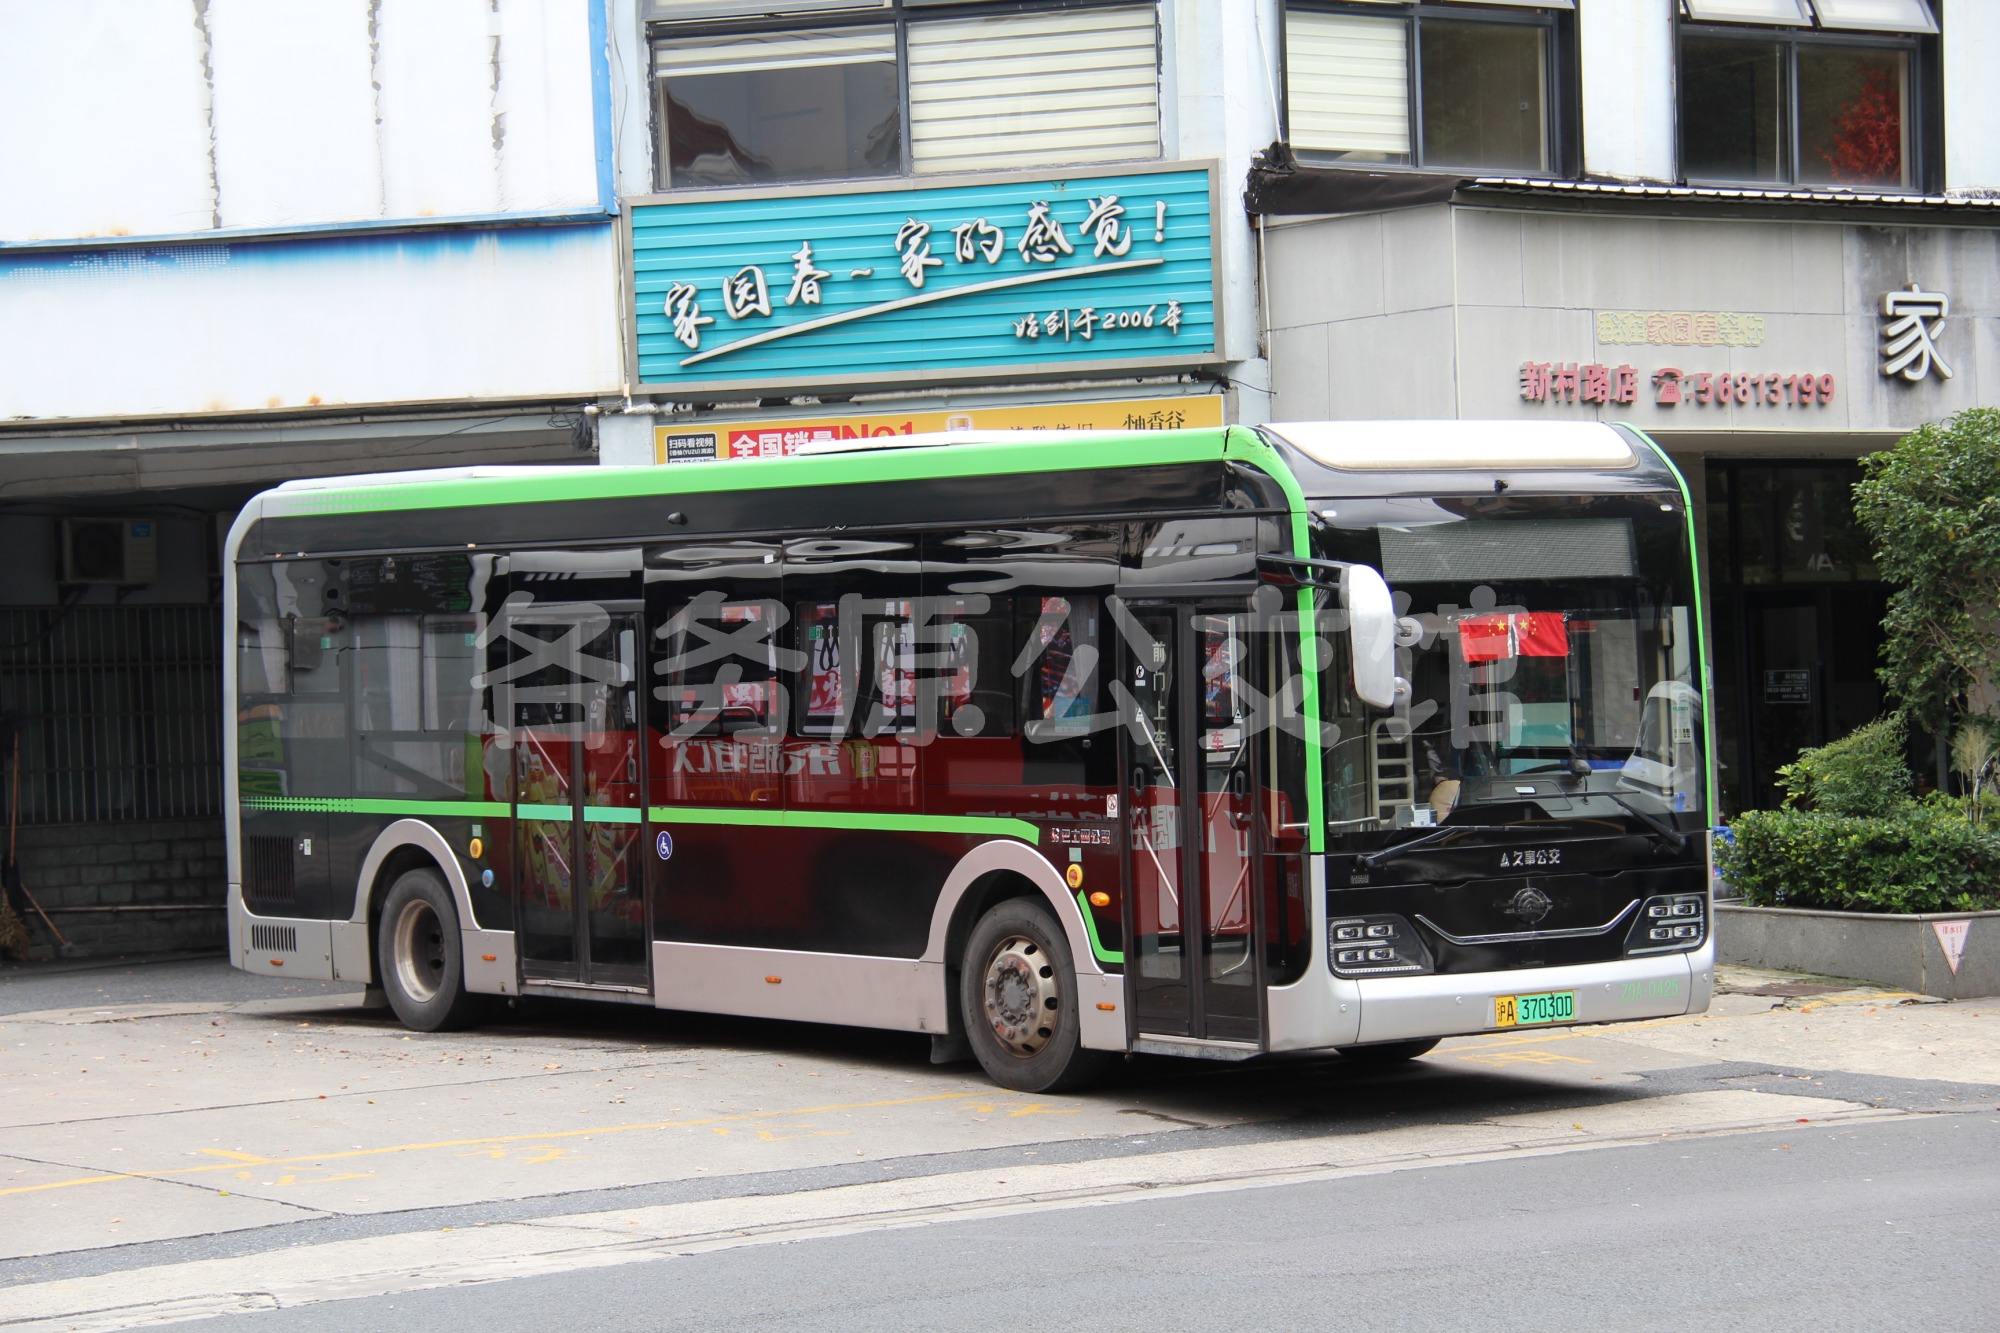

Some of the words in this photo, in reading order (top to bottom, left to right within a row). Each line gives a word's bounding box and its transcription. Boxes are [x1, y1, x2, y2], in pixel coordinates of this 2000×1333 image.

[1879, 283, 1953, 381] 家
[1520, 361, 1638, 403] 新村路店
[669, 437, 714, 449] 扫码看视频
[1152, 641, 1167, 751] 前门上车
[1210, 642, 1225, 752] 前门上车
[1512, 849, 1561, 866] 久事公交
